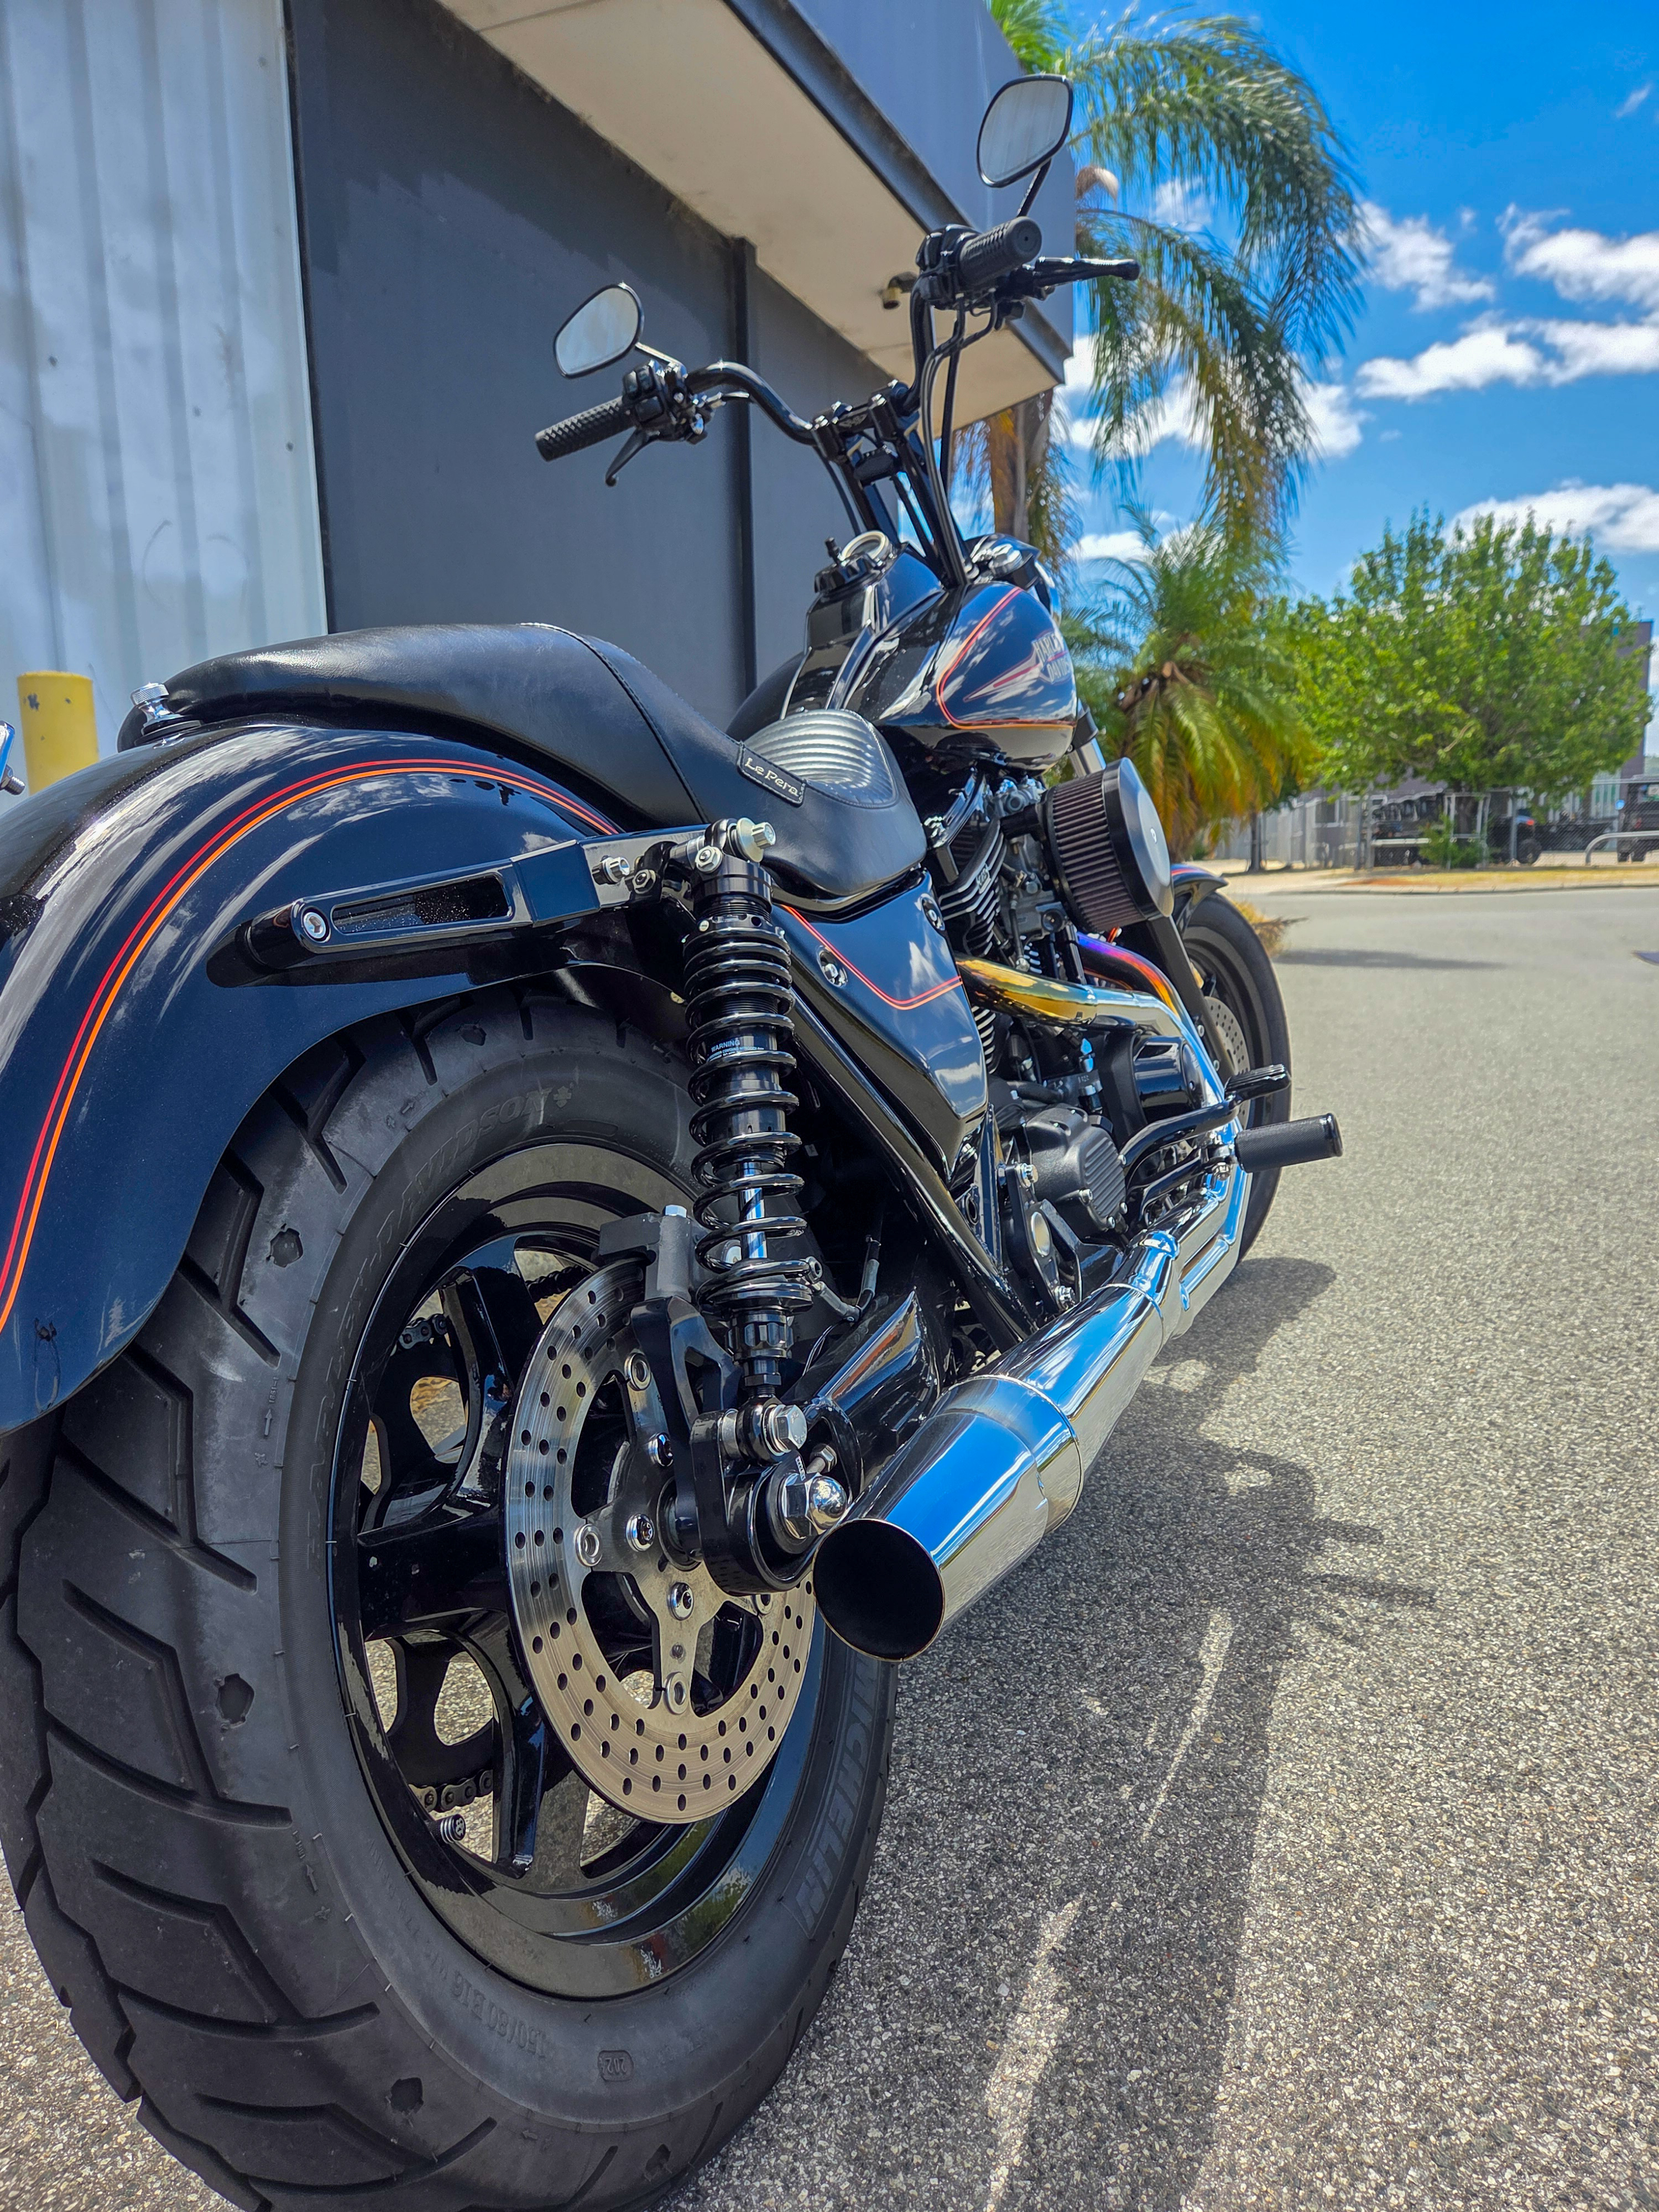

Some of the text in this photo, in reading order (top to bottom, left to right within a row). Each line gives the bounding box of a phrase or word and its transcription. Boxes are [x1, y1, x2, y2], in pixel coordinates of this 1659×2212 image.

[744, 757, 800, 797] Le Pera
[711, 1039, 740, 1053] WARNING
[795, 1652, 879, 1931] MICHELIN
